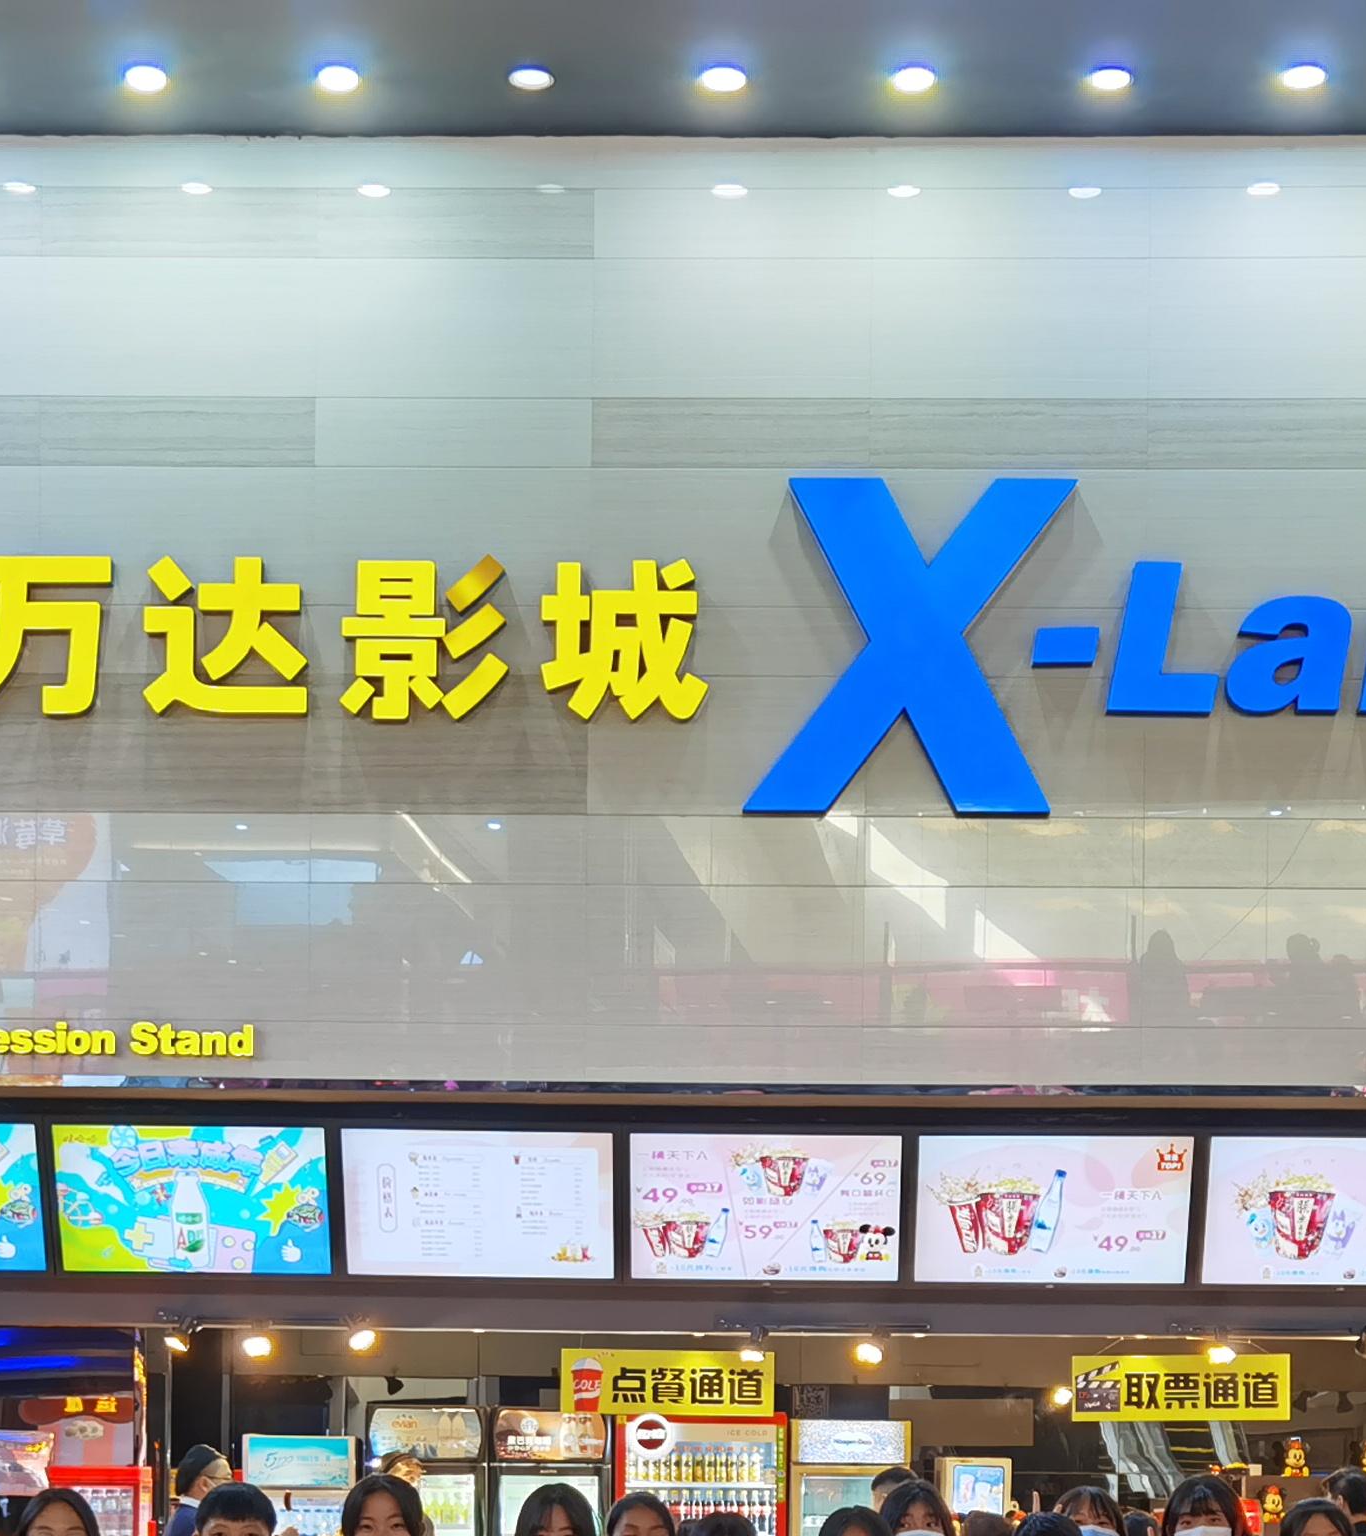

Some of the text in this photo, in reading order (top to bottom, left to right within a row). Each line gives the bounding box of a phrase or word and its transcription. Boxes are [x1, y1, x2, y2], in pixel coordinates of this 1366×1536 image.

[129, 1022, 254, 1057] Stand
[612, 1367, 764, 1405] 点餐通道
[1123, 1372, 1279, 1409] 取票通道
